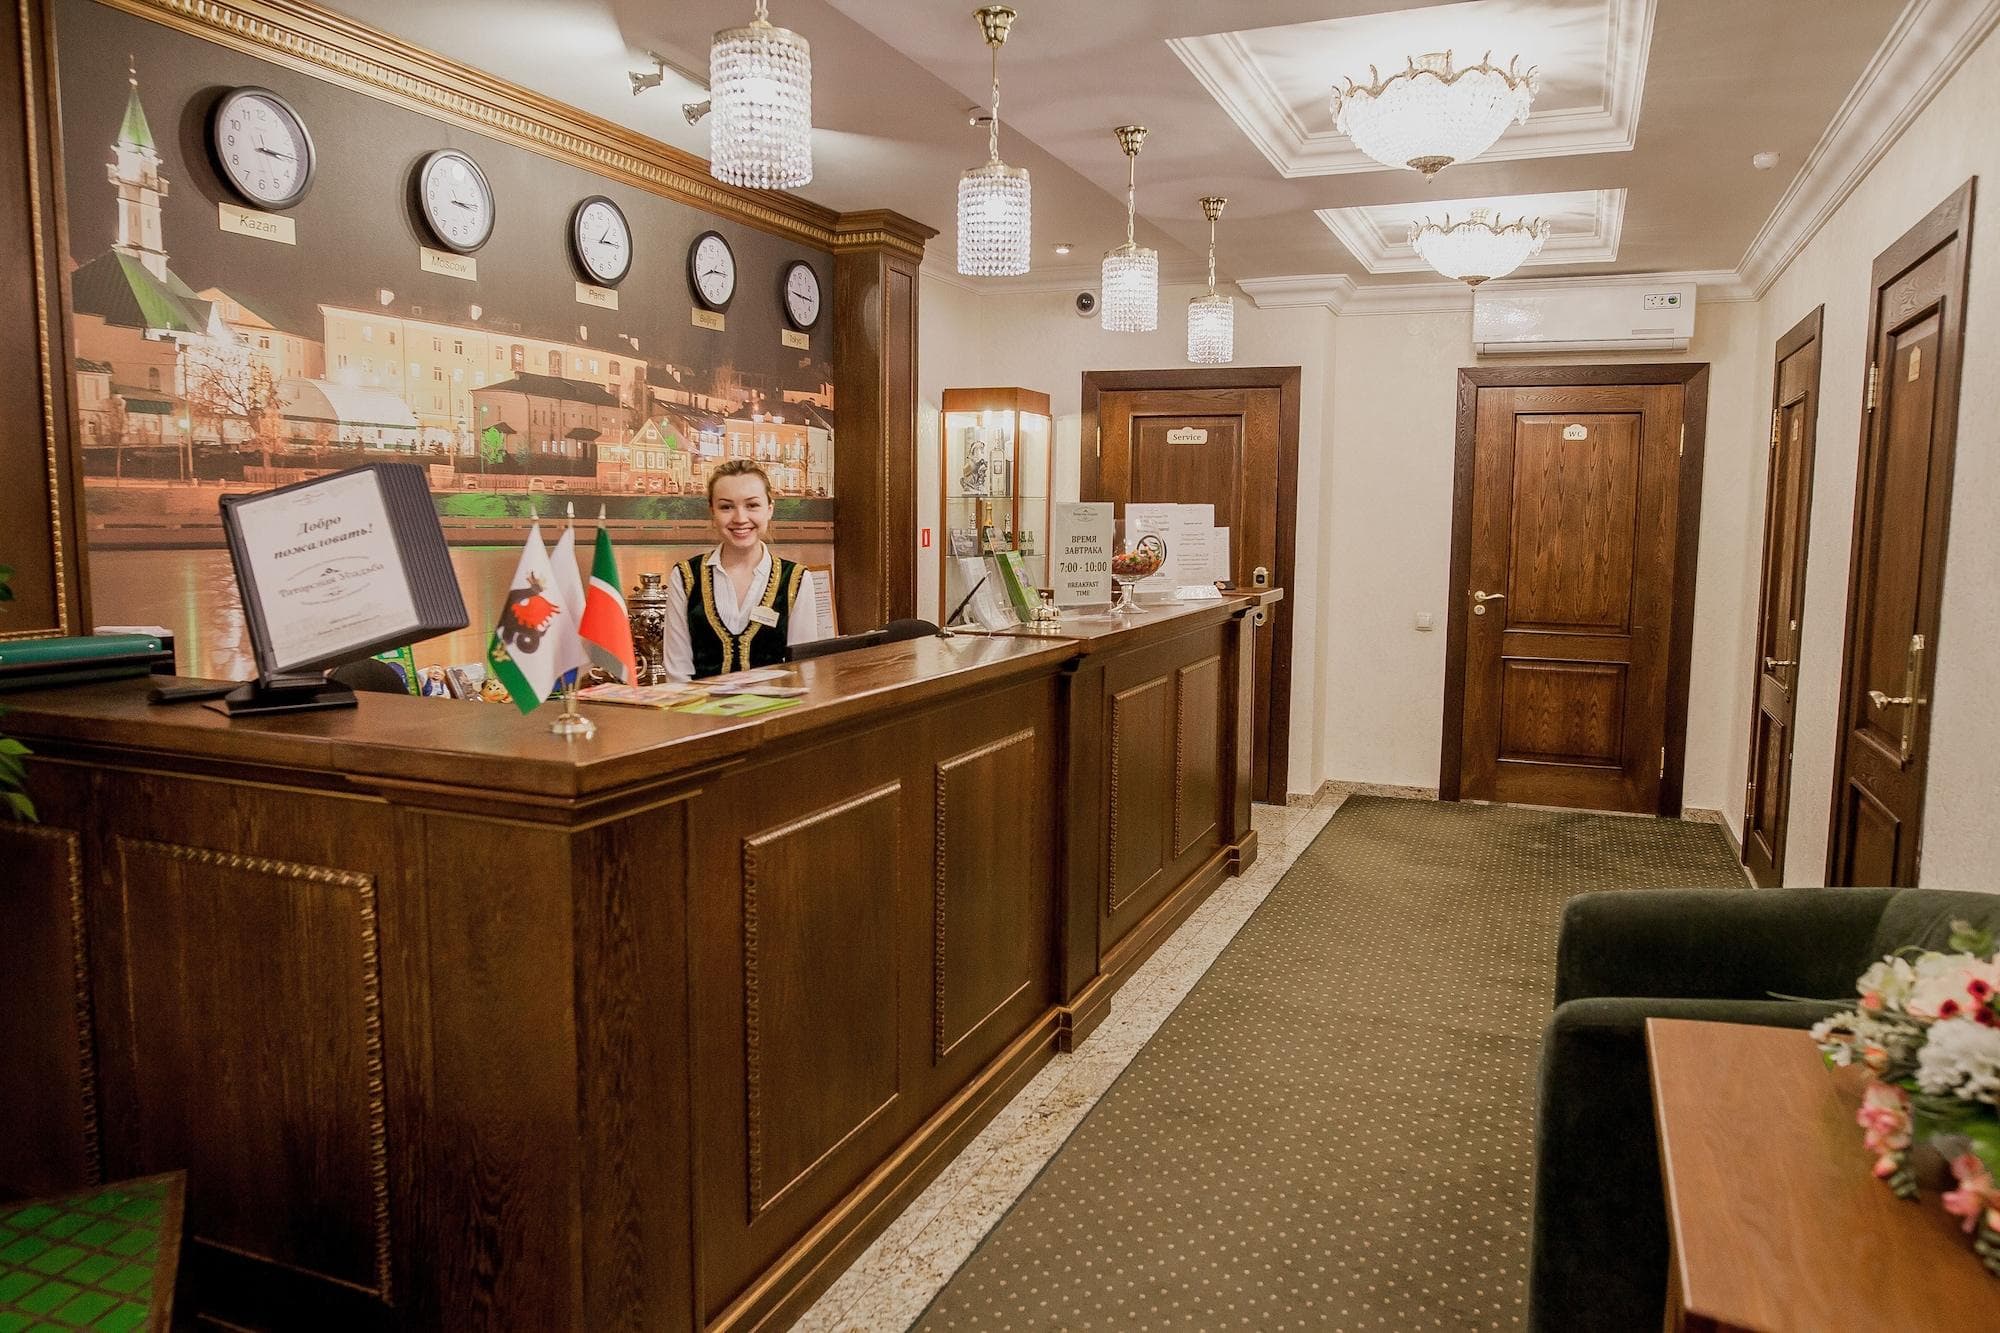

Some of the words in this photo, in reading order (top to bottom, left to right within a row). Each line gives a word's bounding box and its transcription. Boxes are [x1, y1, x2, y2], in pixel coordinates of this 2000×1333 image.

[242, 109, 251, 121] 11
[256, 110, 266, 121] 12
[230, 120, 241, 132] 10
[227, 134, 235, 146] 9
[232, 154, 239, 166] 8
[243, 170, 251, 181] 7
[258, 179, 266, 190] 6
[273, 178, 280, 189] 5
[430, 190, 435, 200] 9
[432, 206, 439, 217] 8
[240, 214, 277, 233] Kazan
[452, 226, 458, 236] 6
[463, 225, 468, 235] 5
[432, 255, 467, 273] Moscow
[589, 289, 605, 302] Paris
[296, 516, 341, 536] Добро
[274, 522, 373, 559] пожаловать!
[1060, 562, 1077, 572] 7:00
[1085, 562, 1107, 572] 10:00
